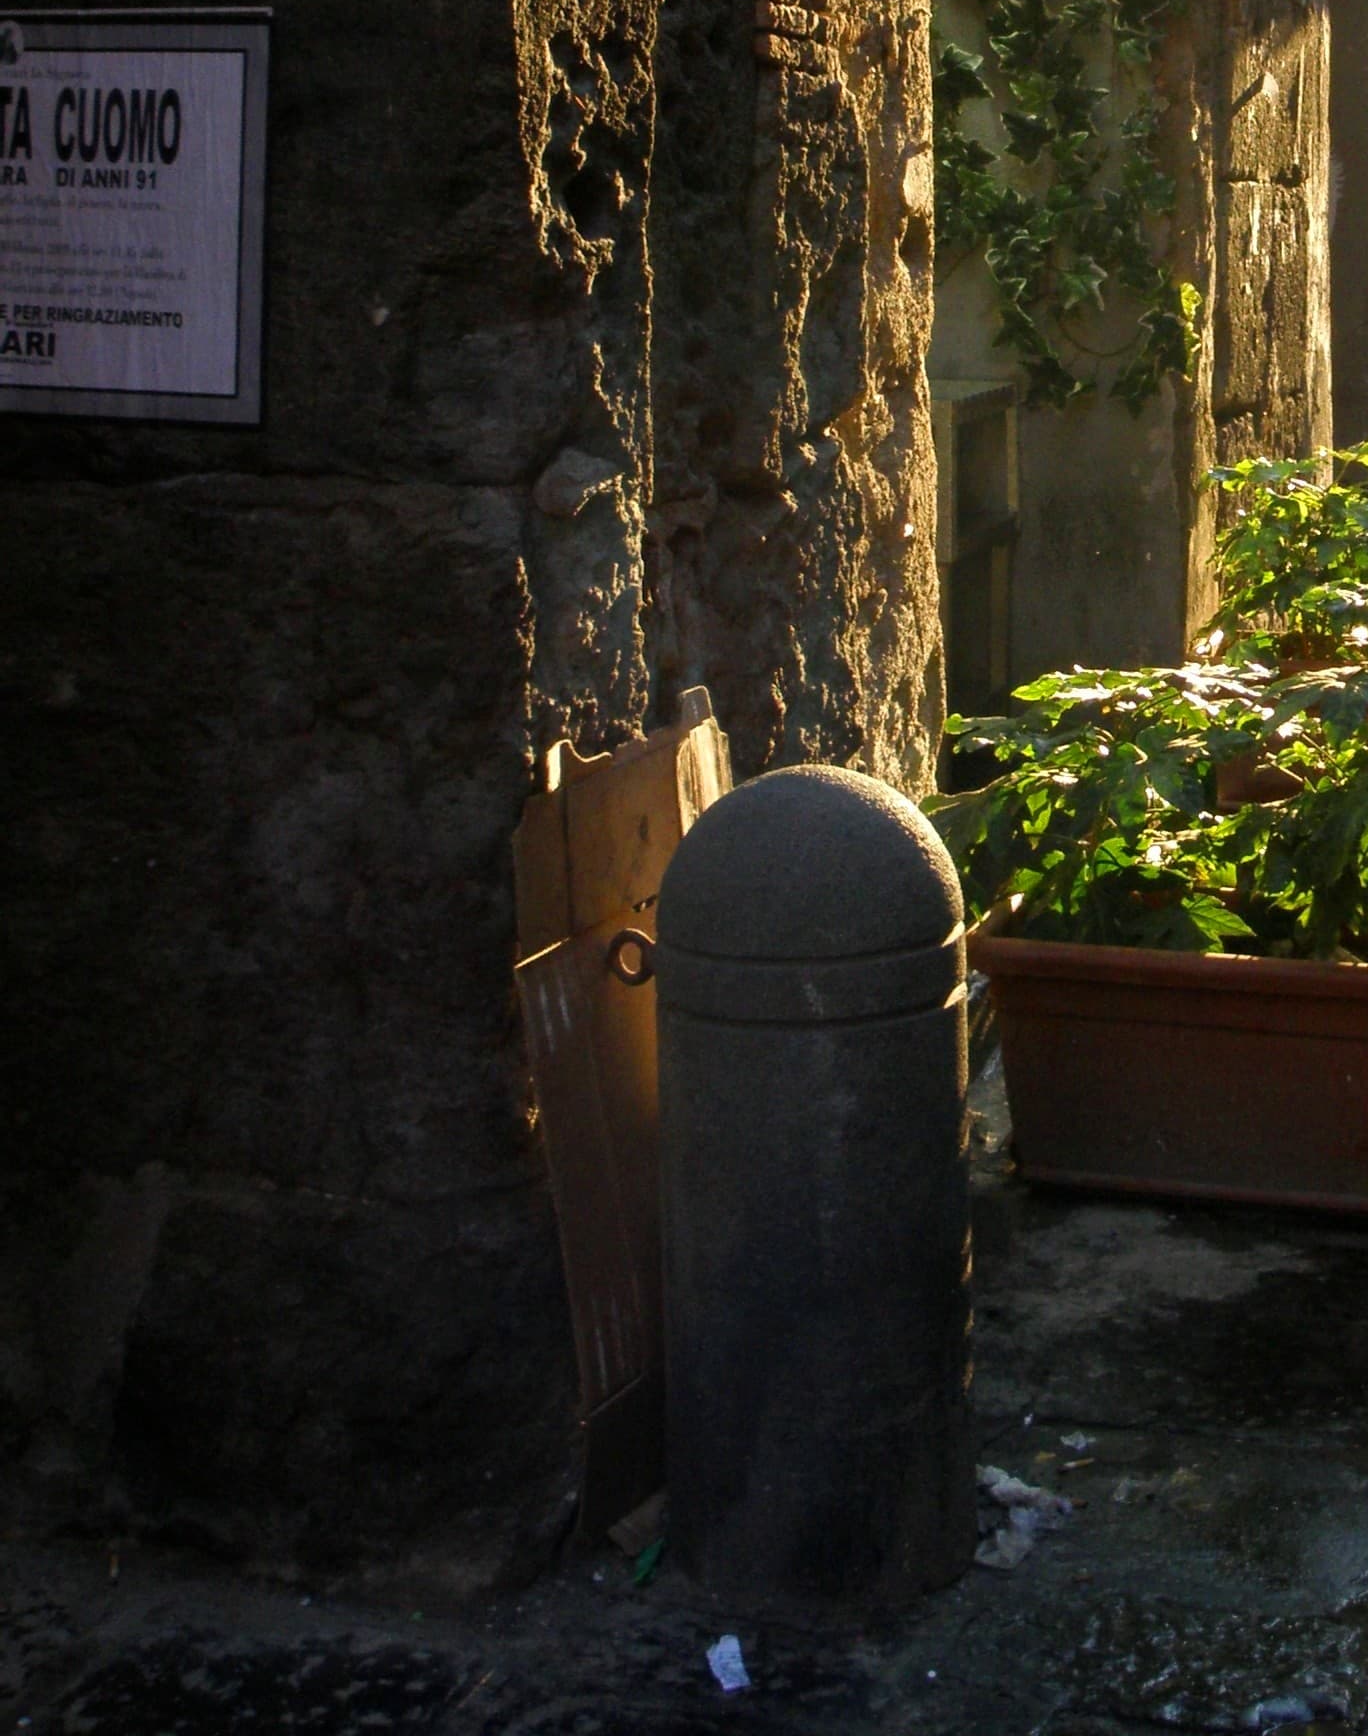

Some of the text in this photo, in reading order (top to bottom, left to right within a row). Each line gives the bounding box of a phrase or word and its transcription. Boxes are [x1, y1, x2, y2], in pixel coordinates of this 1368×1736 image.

[55, 87, 181, 165] CUOMO
[55, 168, 75, 188] DI
[82, 169, 129, 189] ANNI
[135, 170, 158, 190] 91
[13, 304, 41, 320] PER
[46, 305, 183, 328] RINGRAZIAMENTO
